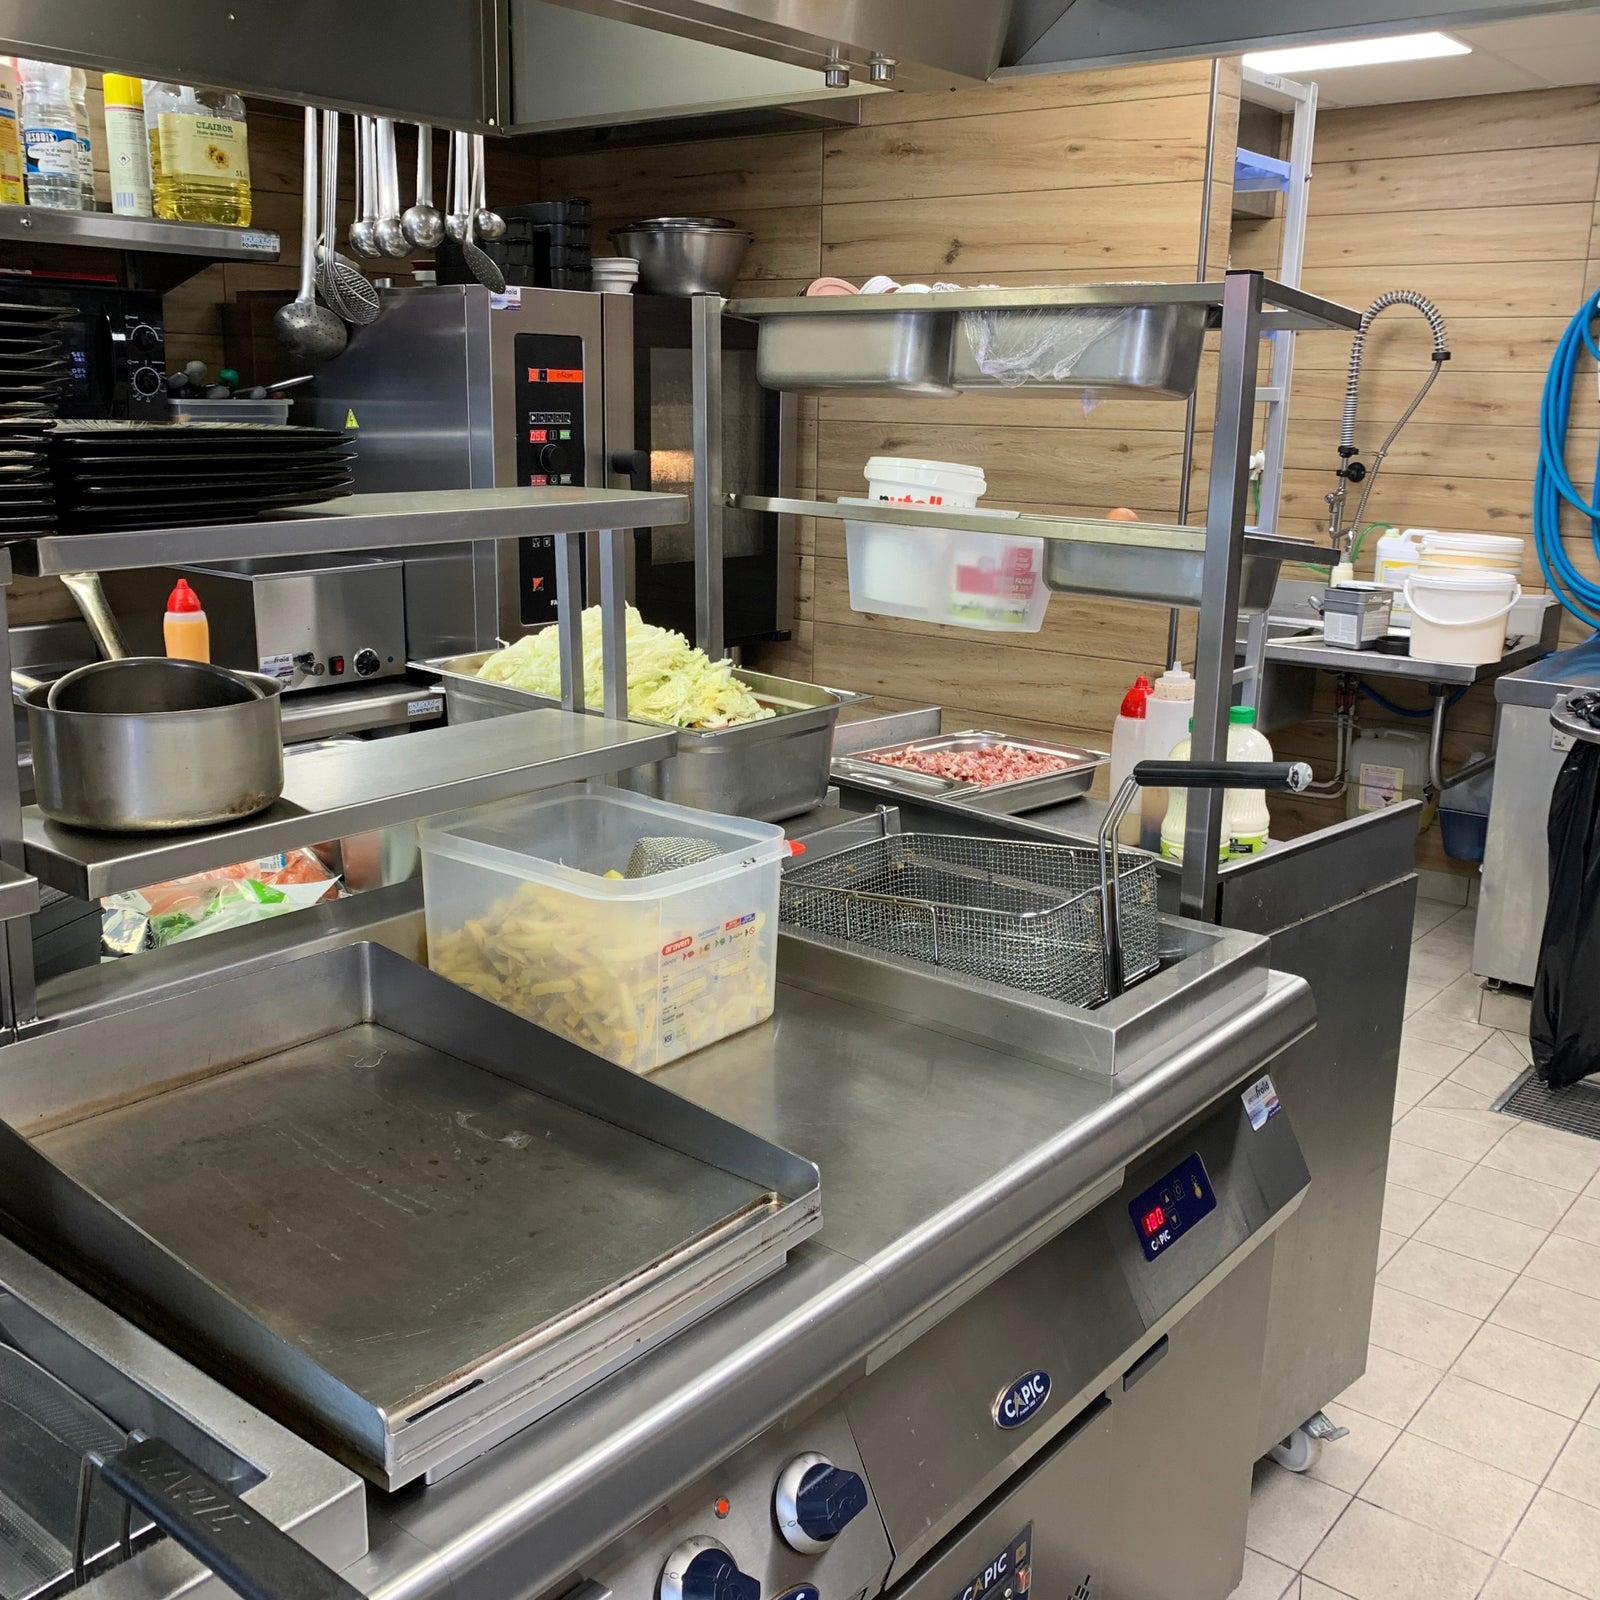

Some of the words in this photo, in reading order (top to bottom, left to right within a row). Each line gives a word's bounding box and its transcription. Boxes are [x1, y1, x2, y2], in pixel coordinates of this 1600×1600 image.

[195, 121, 234, 133] CLAIROR
[664, 937, 691, 954] araven
[1151, 1229, 1171, 1251] CAPIC
[1004, 1374, 1045, 1418] CAPIC
[962, 1552, 1008, 1600] CAPIC
